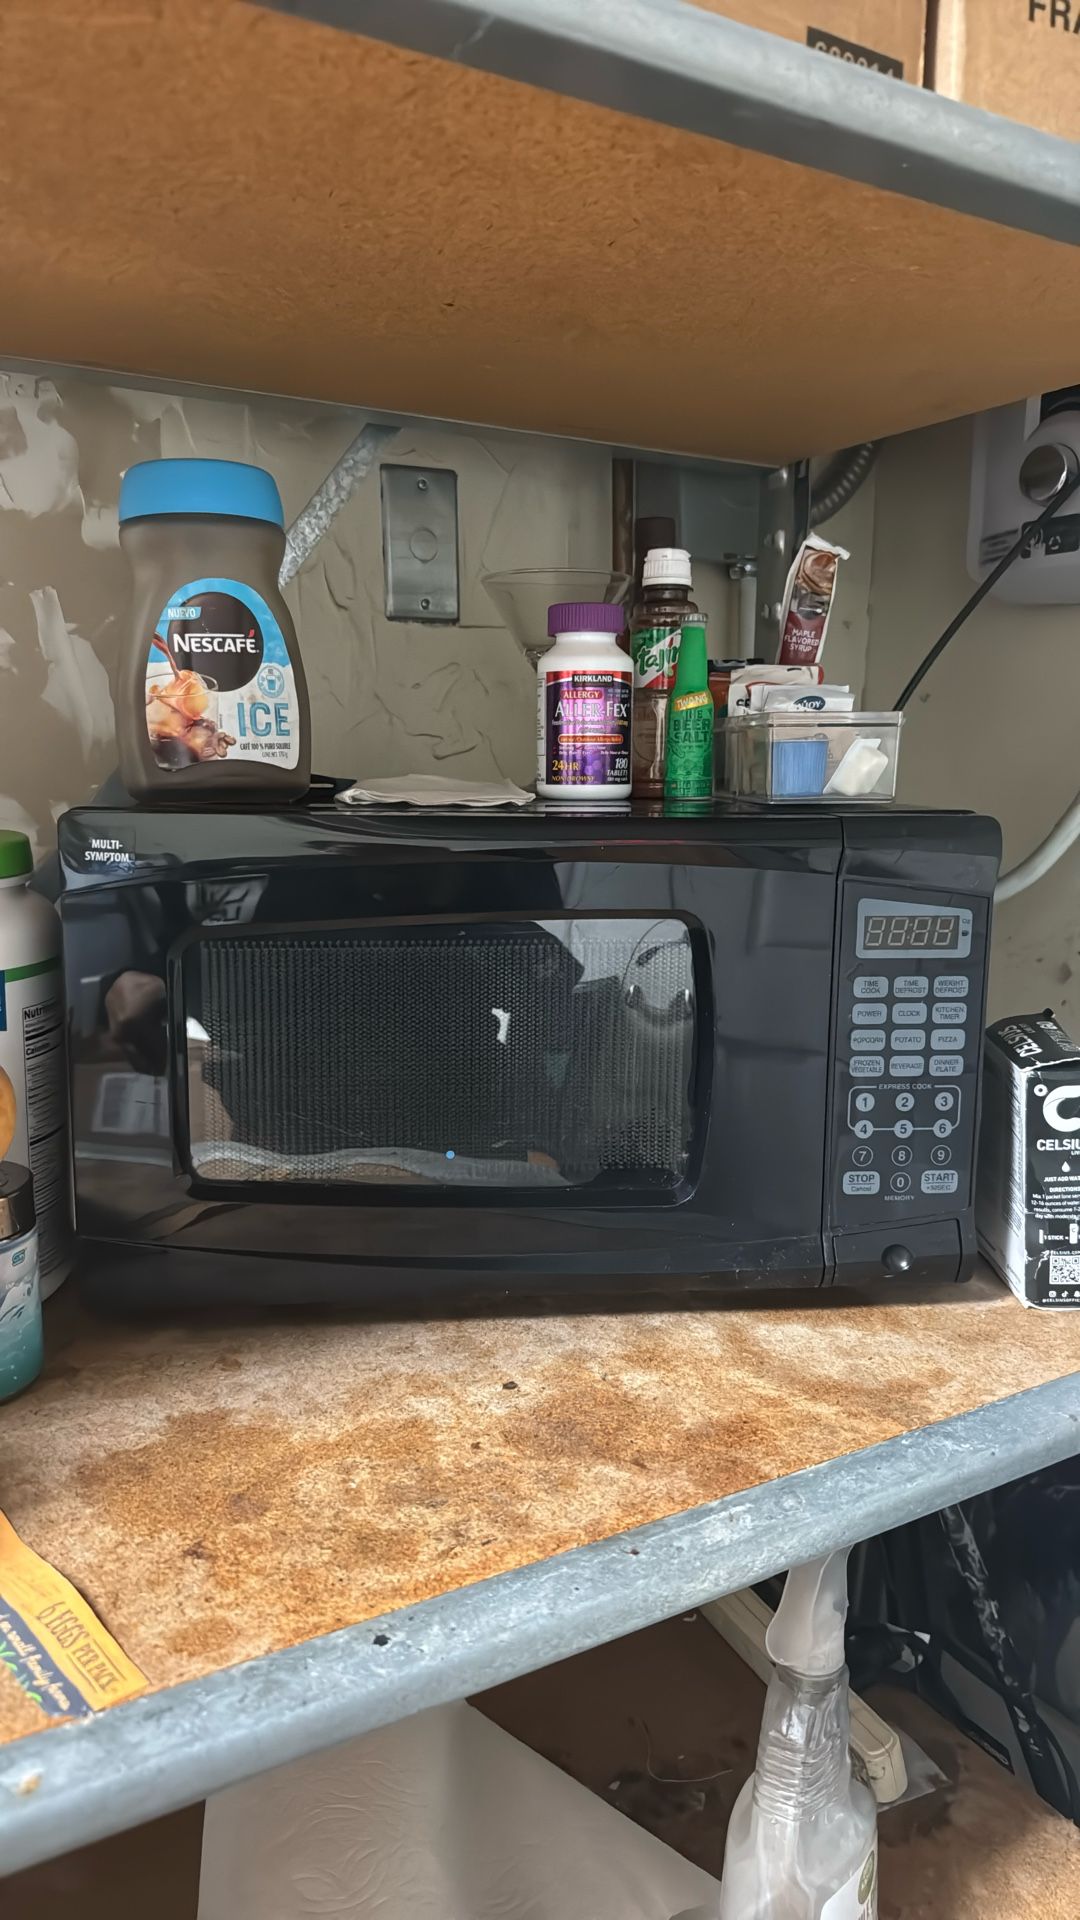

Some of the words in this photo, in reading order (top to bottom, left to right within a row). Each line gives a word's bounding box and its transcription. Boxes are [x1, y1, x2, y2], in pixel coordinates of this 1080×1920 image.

[167, 608, 196, 618] NUEVO
[792, 628, 816, 639] MAPLE
[173, 629, 257, 653] NESCAFÉ
[784, 634, 820, 647] FLAVORED
[789, 643, 813, 653] SYRUP
[563, 690, 600, 699] ALLERGY
[676, 692, 708, 708] TWANG
[237, 702, 291, 737] ICE
[673, 719, 711, 731] BEER
[673, 731, 709, 744] SALT
[91, 838, 123, 850] MULTI-
[84, 850, 130, 862] SYMPTOM
[938, 979, 964, 987] WEIGHT
[863, 1097, 868, 1107] 1
[901, 1097, 909, 1107] 2
[940, 1096, 948, 1107] 3
[859, 1124, 868, 1134] 4
[900, 1124, 907, 1134] 5
[939, 1123, 946, 1134] 6
[859, 1151, 867, 1161] 7
[898, 1150, 906, 1161] 8
[937, 1150, 945, 1161] 9
[848, 1174, 875, 1183] STOP
[897, 1177, 904, 1188] 0
[924, 1173, 955, 1181] START
[35, 1601, 65, 1621] 6
[44, 1608, 90, 1649] EGGS
[71, 1642, 100, 1668] PER
[87, 1661, 119, 1690] PACK
